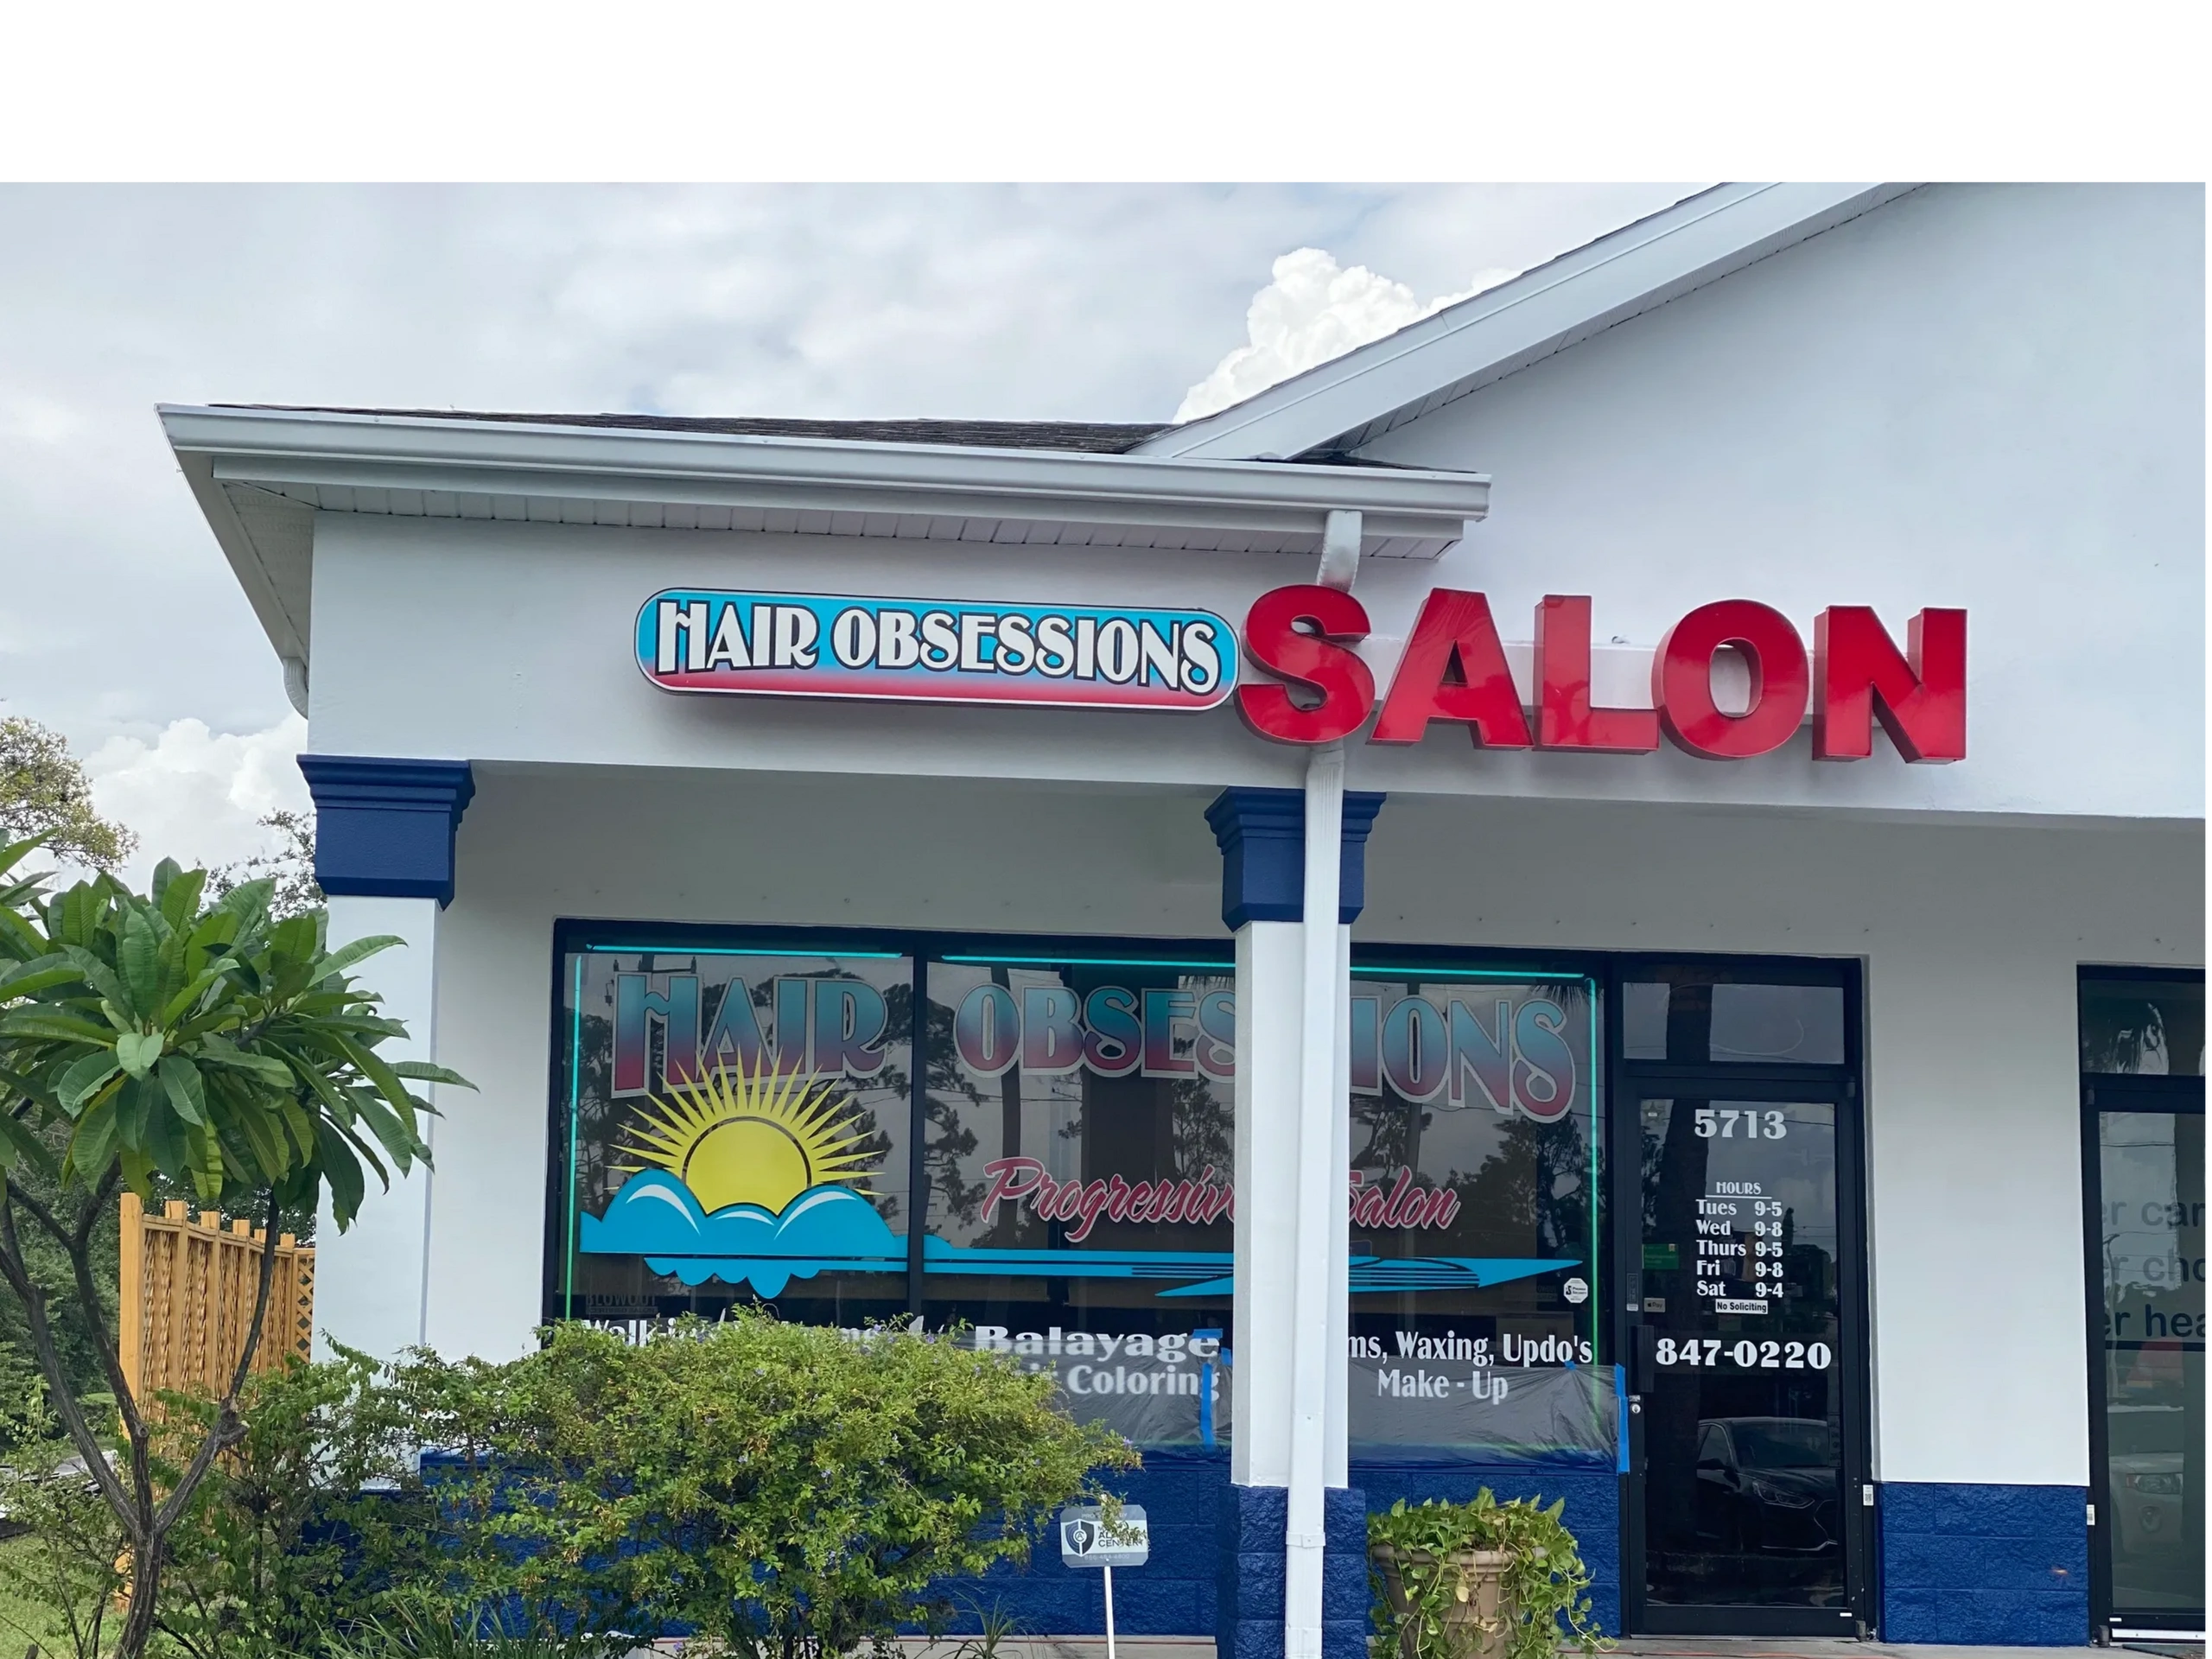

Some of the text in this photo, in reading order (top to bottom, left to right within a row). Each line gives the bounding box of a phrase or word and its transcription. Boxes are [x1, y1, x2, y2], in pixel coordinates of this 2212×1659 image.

[657, 601, 1221, 695] HAIR OBSESSIONS
[1235, 584, 1967, 765] SALON
[609, 971, 1576, 1123] HAIR OBSESIONS
[1694, 1109, 1788, 1140] 5713
[981, 1157, 1235, 1243] Progressiv
[1716, 1181, 1762, 1195] HOURS
[1695, 1199, 1783, 1217] Tues 9-5
[1695, 1219, 1783, 1237] Wed 9-8
[1695, 1239, 1783, 1257] Thurs 9-5
[1696, 1260, 1784, 1278] Fri 9-8
[1696, 1281, 1784, 1298] Sat 9-4
[1717, 1301, 1767, 1313] No Soliciting
[975, 1325, 1220, 1363] Balayage
[1395, 1330, 1495, 1367] Waxing,
[1503, 1333, 1592, 1368] Updo's
[1656, 1338, 1832, 1370] 847-0220
[1377, 1369, 1450, 1398] Make
[1471, 1370, 1509, 1405] Up
[1098, 1539, 1139, 1548] CENER
